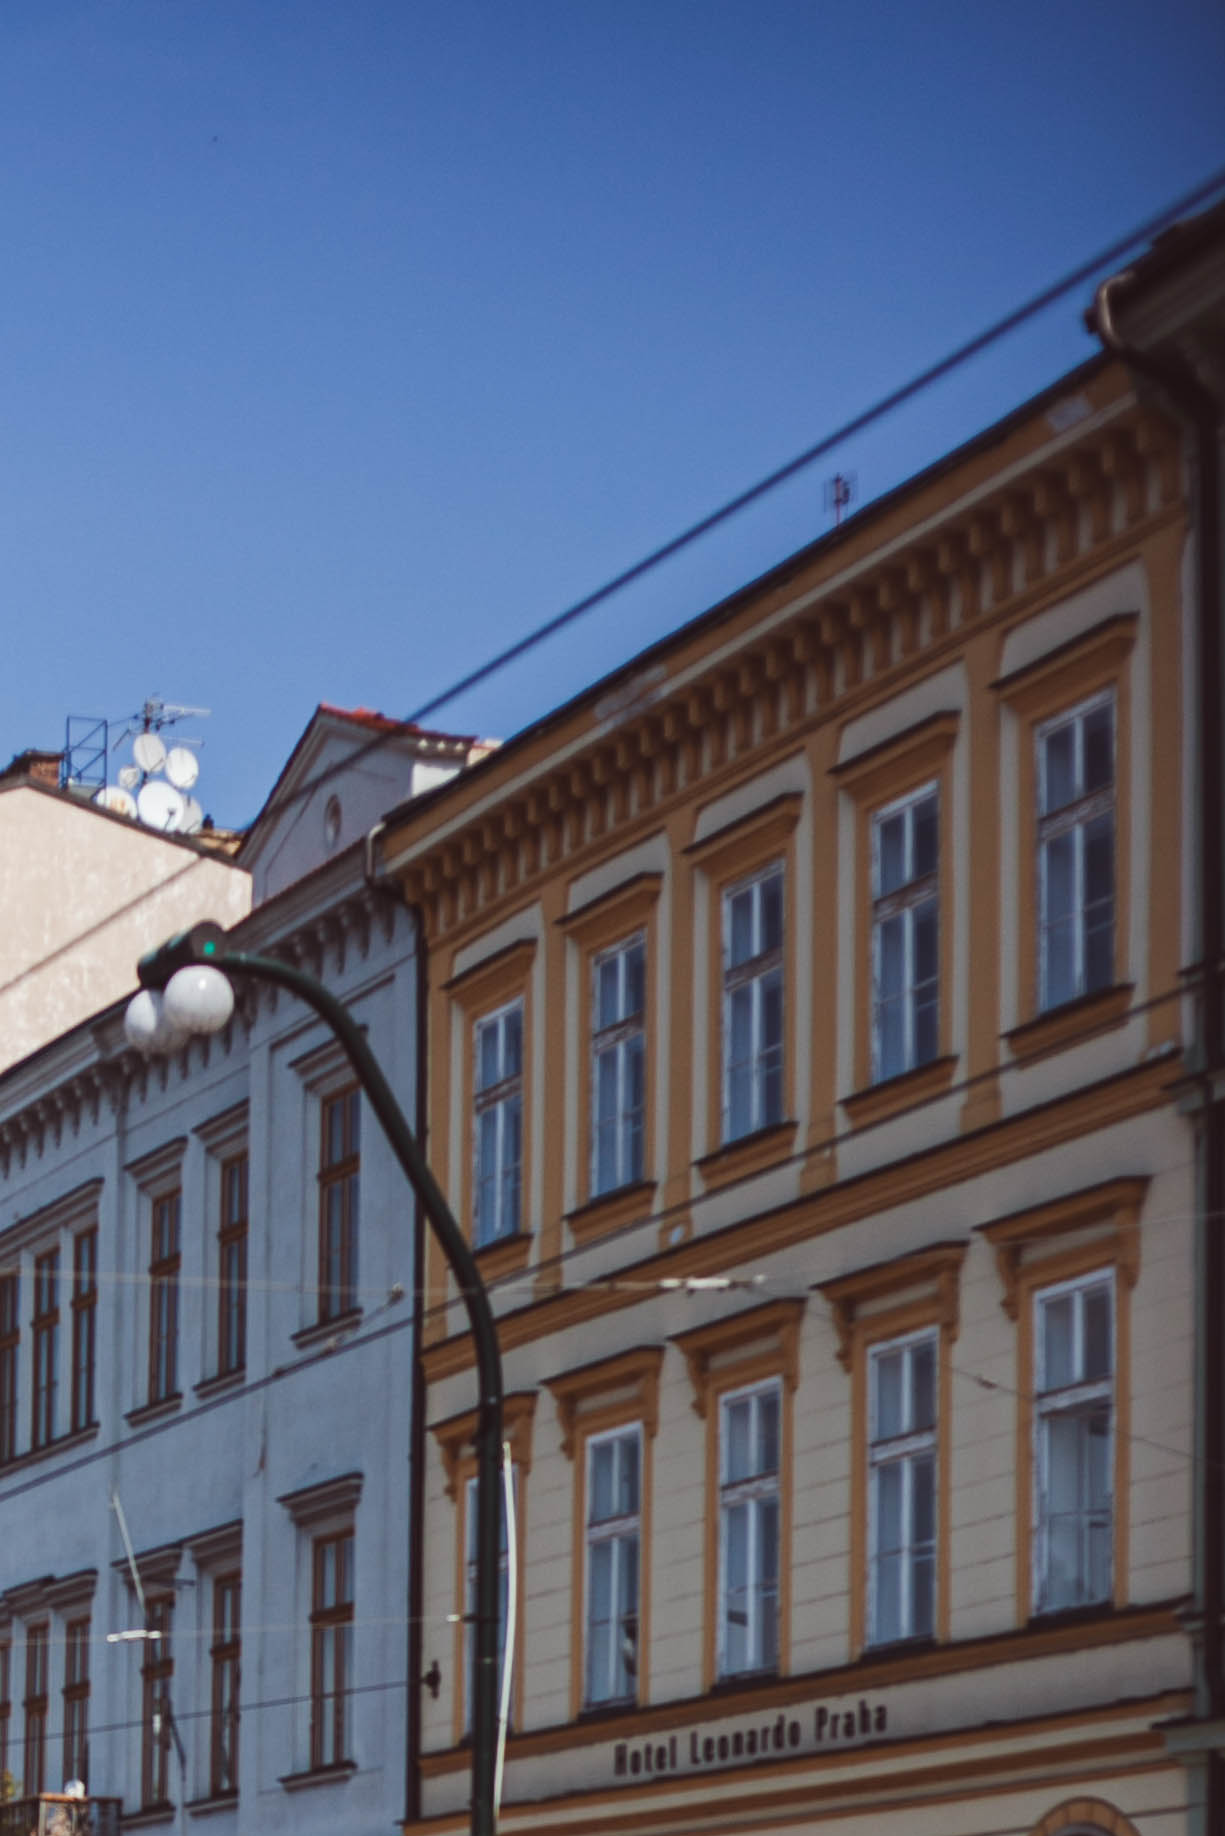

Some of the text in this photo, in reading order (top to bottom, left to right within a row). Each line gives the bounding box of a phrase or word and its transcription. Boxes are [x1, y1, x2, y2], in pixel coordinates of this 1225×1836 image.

[613, 1699, 888, 1776] Hotel Leonardo Praha
